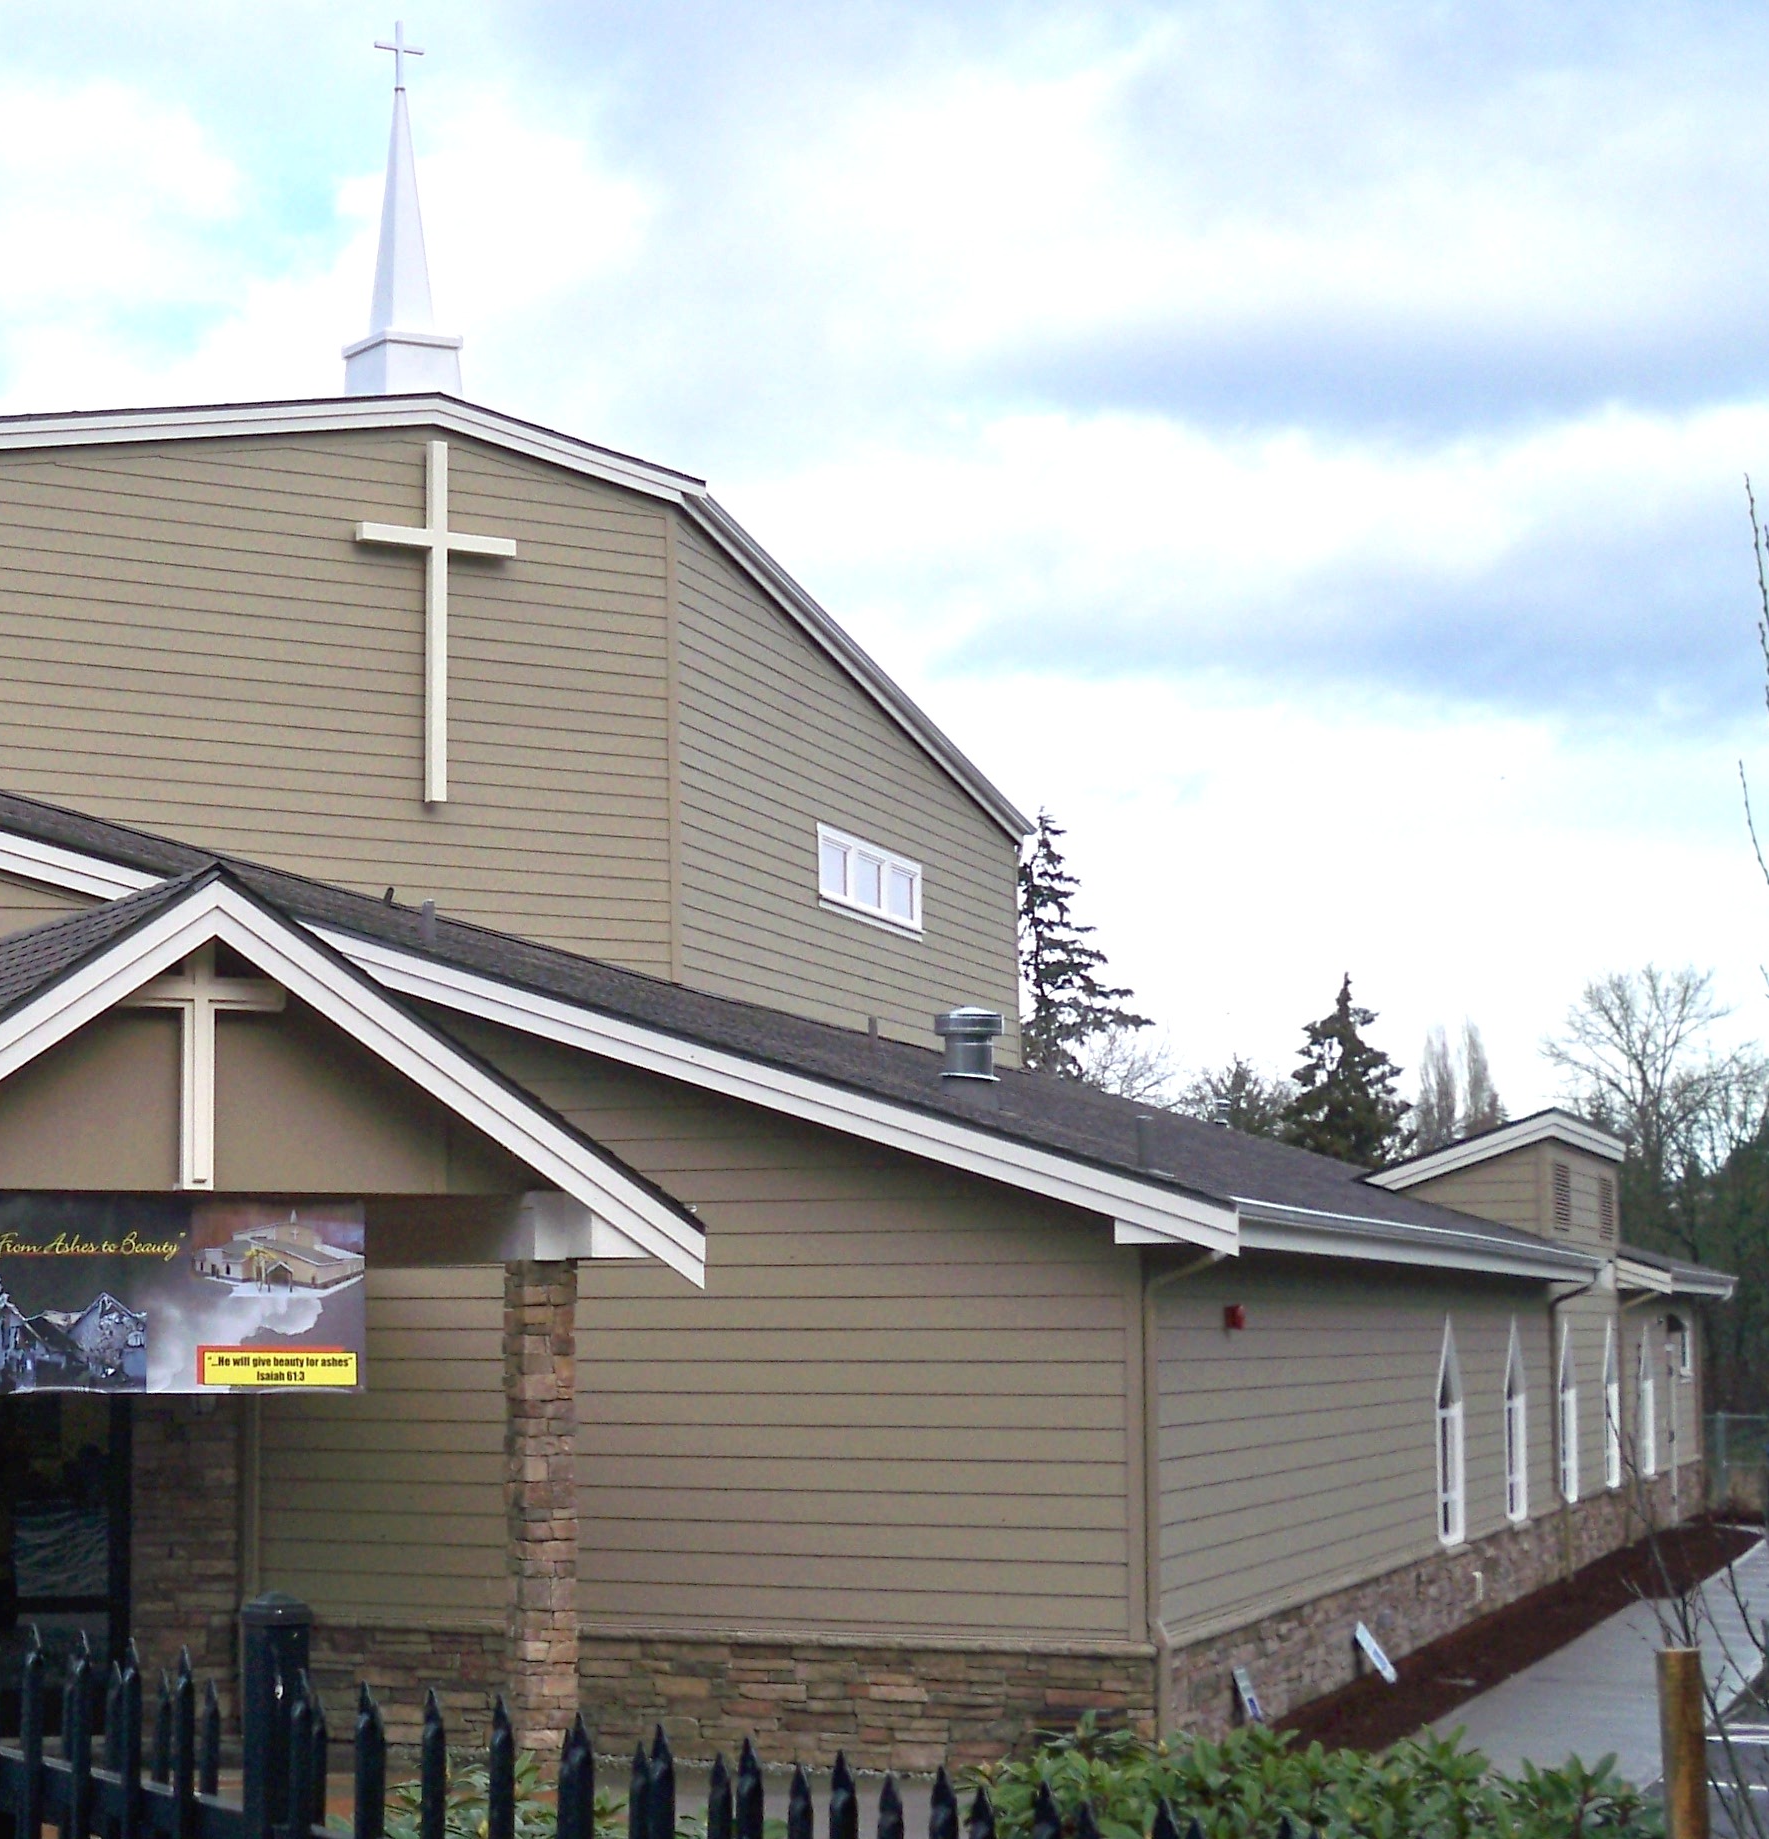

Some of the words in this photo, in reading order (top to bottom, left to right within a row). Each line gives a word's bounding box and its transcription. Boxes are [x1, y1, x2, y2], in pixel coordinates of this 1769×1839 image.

[44, 1232, 99, 1255] Ashes
[102, 1238, 118, 1253] to
[233, 1356, 250, 1367] will
[253, 1356, 271, 1367] give
[273, 1356, 304, 1367] beauty
[306, 1356, 319, 1367] for
[257, 1371, 285, 1381] Isaiah
[287, 1371, 305, 1381] 61:3
